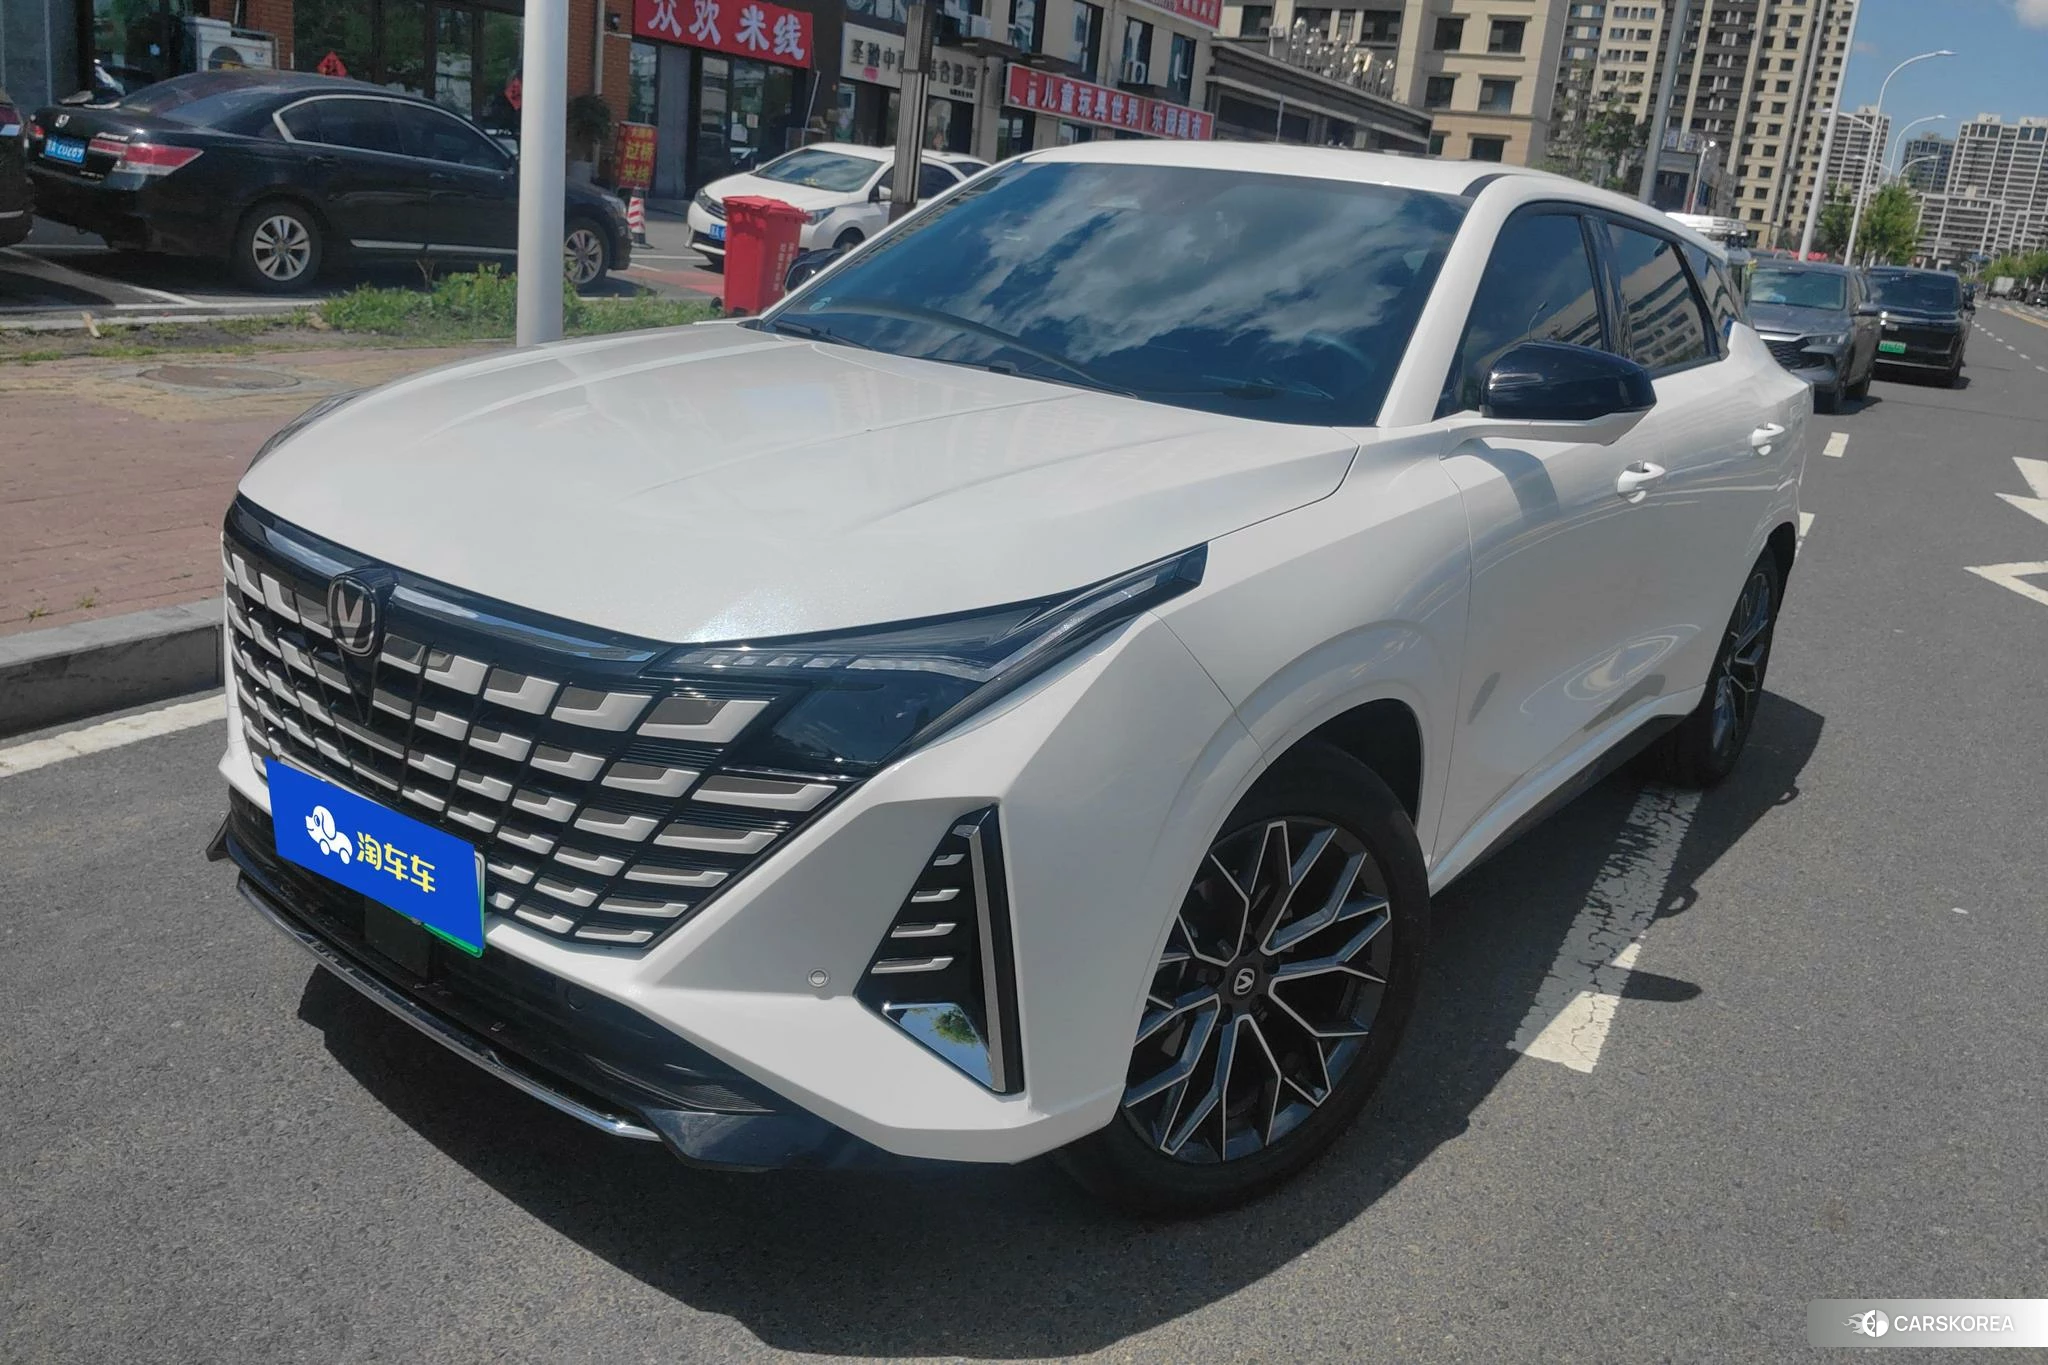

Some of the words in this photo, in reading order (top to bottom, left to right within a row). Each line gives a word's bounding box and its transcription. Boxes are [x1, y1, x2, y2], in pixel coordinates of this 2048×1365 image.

[1041, 77, 1139, 126] 儿童玩具世界
